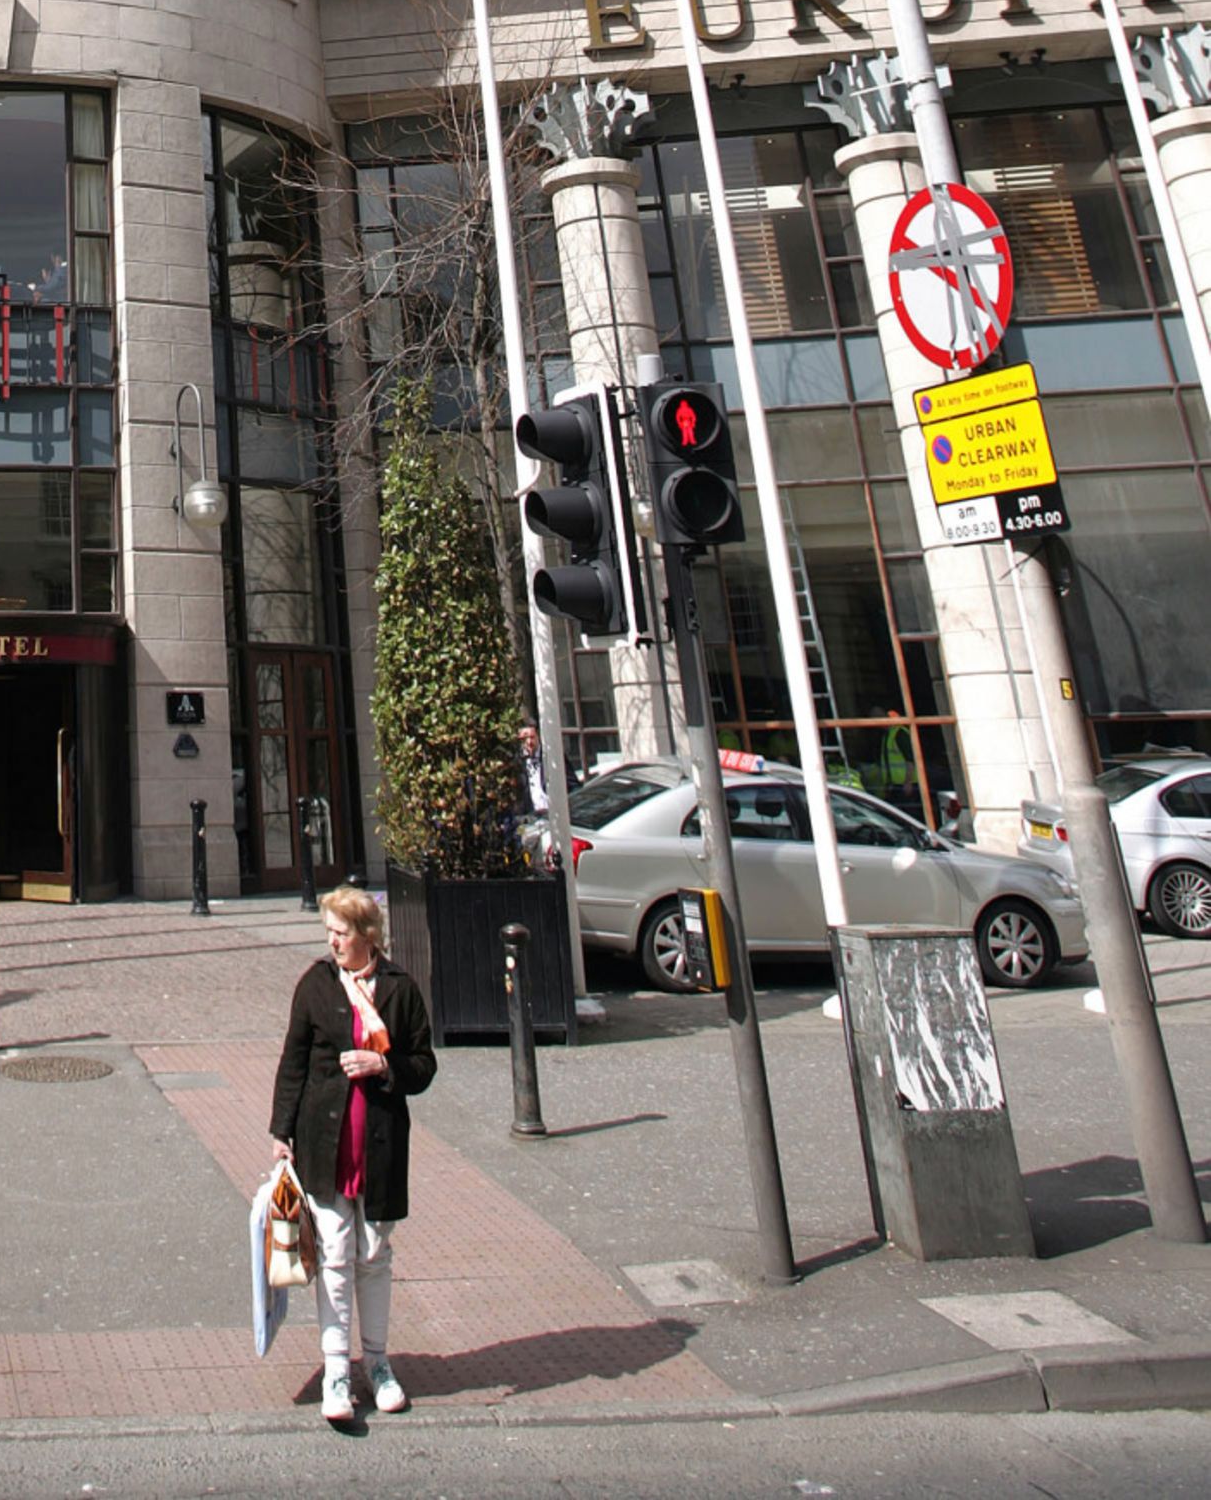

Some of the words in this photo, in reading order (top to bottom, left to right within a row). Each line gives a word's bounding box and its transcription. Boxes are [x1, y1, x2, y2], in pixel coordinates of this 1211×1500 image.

[964, 417, 1017, 441] URBAN
[958, 438, 1038, 468] CLEARWAY
[946, 475, 986, 492] Monday
[989, 473, 1001, 484] to
[1004, 466, 1039, 481] Friday
[958, 506, 977, 519] am
[1017, 495, 1042, 513] pm
[1005, 510, 1062, 532] 4.30-6.00
